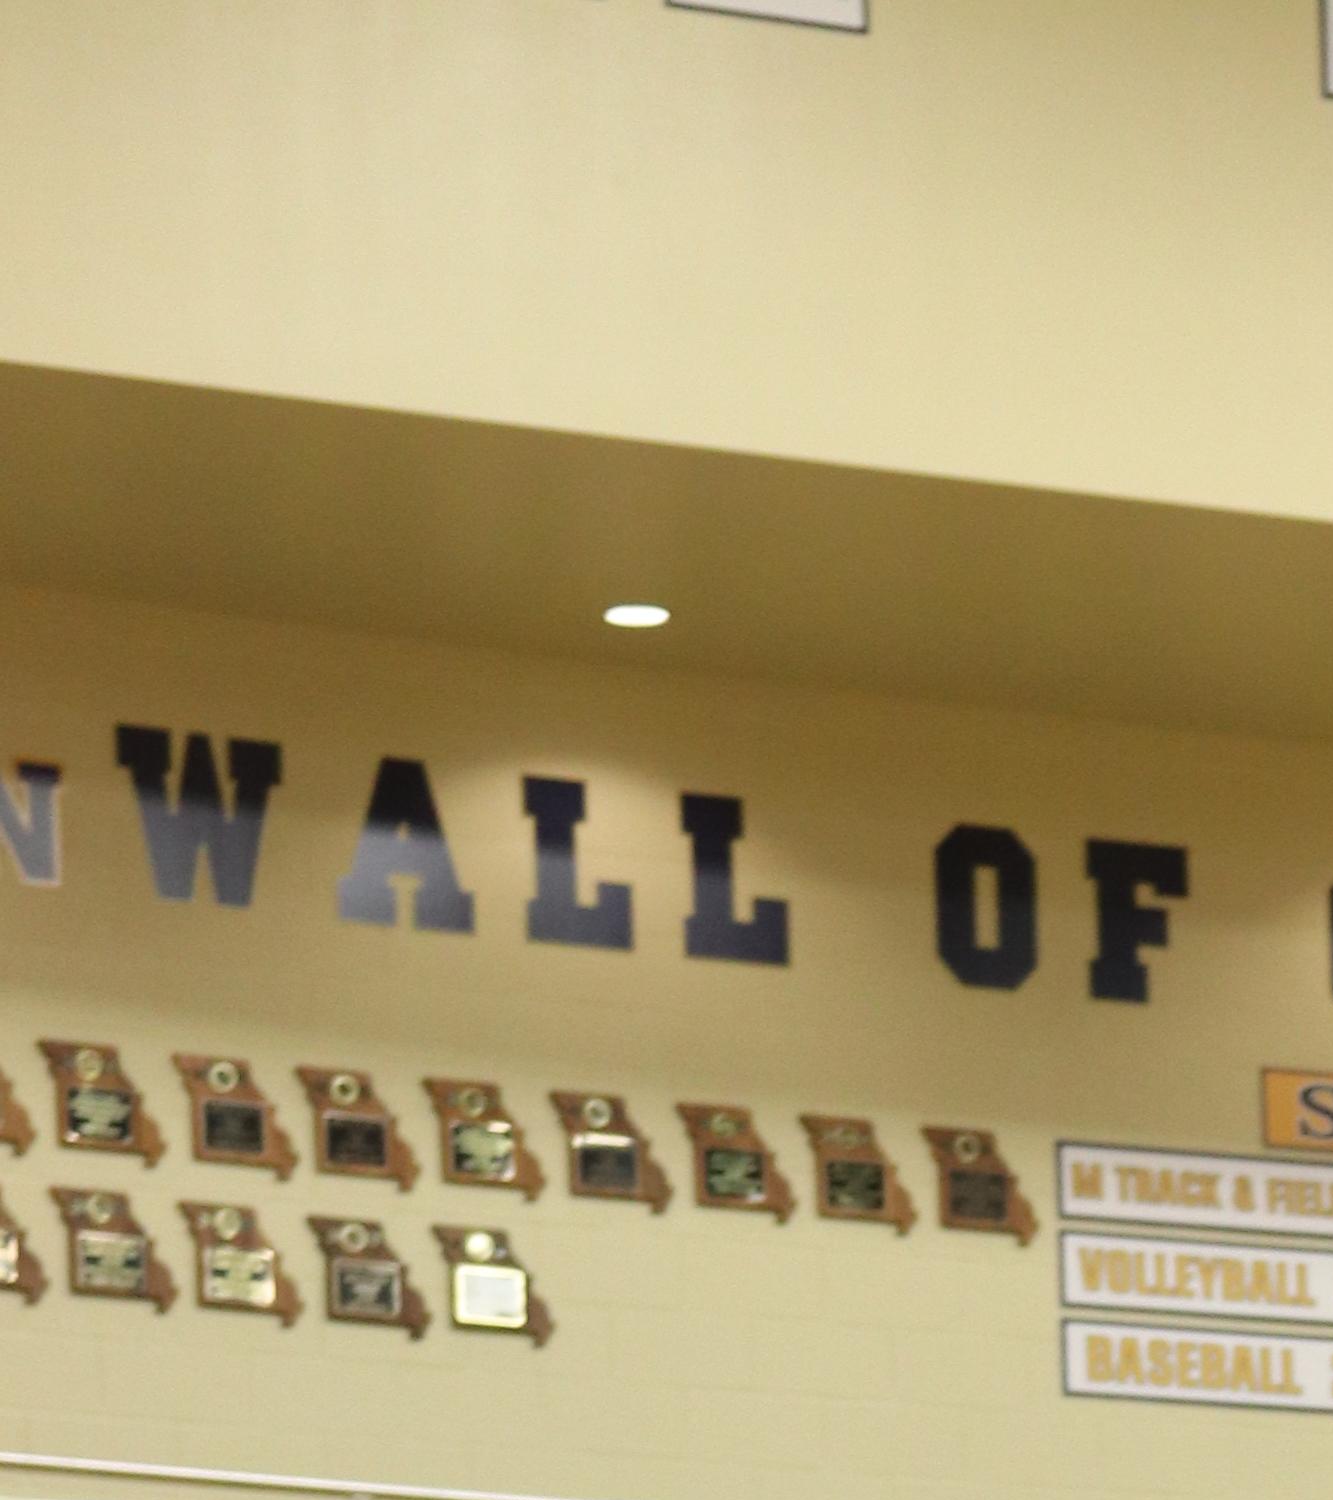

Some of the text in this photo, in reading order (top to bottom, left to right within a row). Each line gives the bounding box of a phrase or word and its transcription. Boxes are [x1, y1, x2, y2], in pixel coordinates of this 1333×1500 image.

[114, 722, 790, 968] WALL
[932, 821, 1190, 1004] OF
[1072, 1161, 1104, 1200] M
[1114, 1165, 1219, 1209] TRACK
[1078, 1244, 1315, 1309] VOLLEYBALL
[1084, 1333, 1303, 1397] BASEBALL
